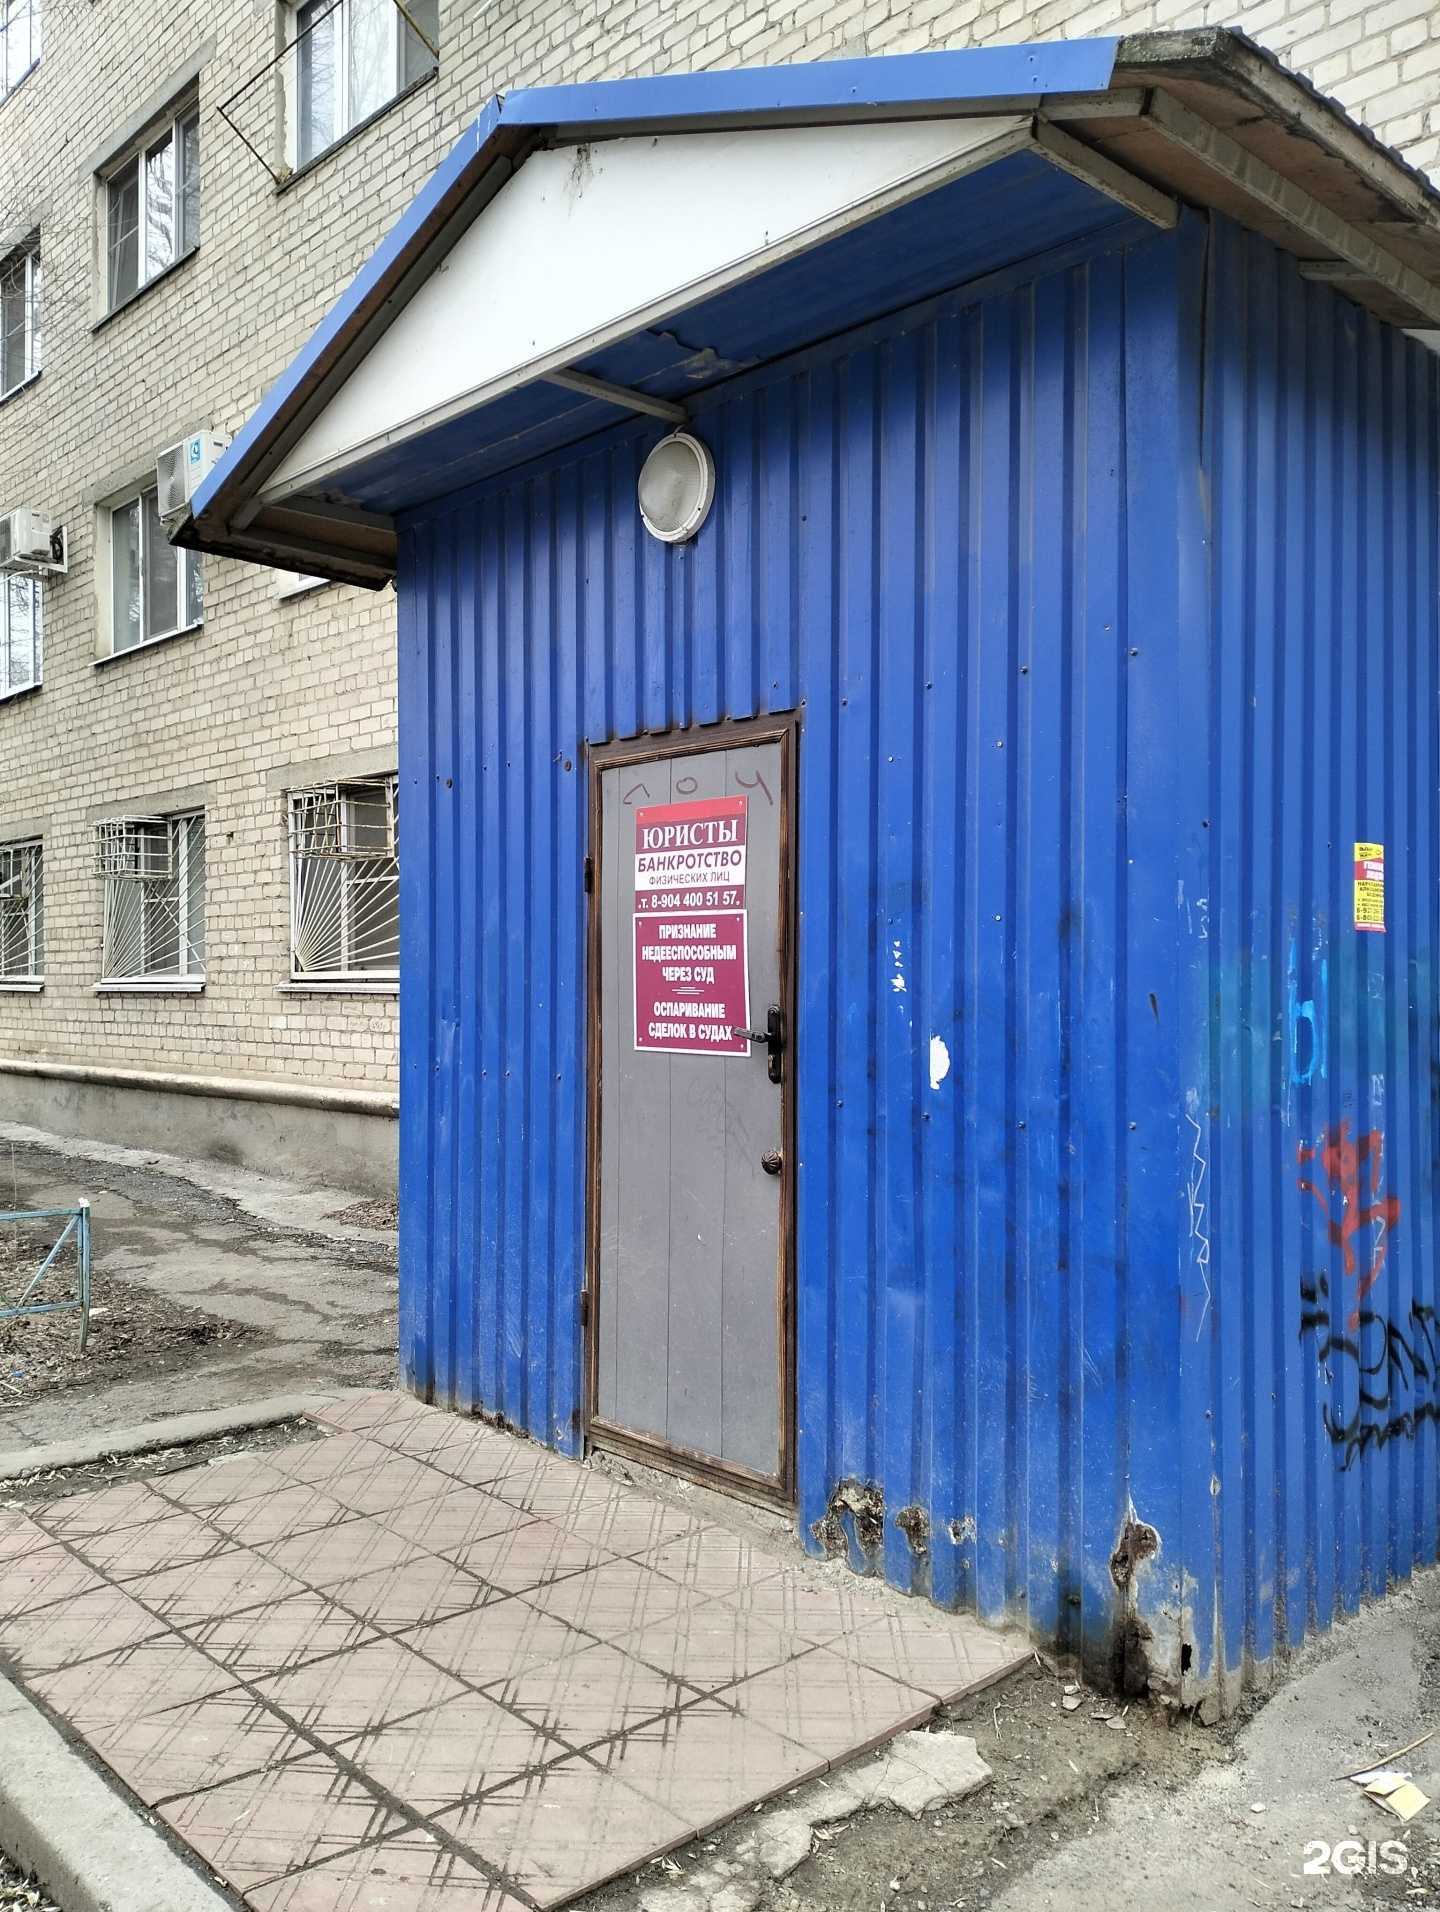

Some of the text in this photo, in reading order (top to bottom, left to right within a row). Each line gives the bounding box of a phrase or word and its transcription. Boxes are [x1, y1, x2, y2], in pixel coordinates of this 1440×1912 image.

[641, 819, 738, 849] ЮРИСТЫ
[638, 849, 742, 873] БАНКРОТСТВО
[648, 871, 730, 885] ФИЗИЧЕСКИХ ЛИЦ
[651, 893, 680, 908] 8-904
[683, 892, 703, 907] 400
[705, 891, 719, 906] 51
[658, 923, 717, 939] ПРИЗНАНИЕ
[641, 944, 737, 963] НЕДЕЕСПОСОБНЫМ
[662, 966, 715, 984] ЧЕРЕЗ СУД
[653, 1001, 726, 1019] ОСПАРИВАНИЕ
[648, 1022, 733, 1042] СДЕЛОК В СУДАХ
